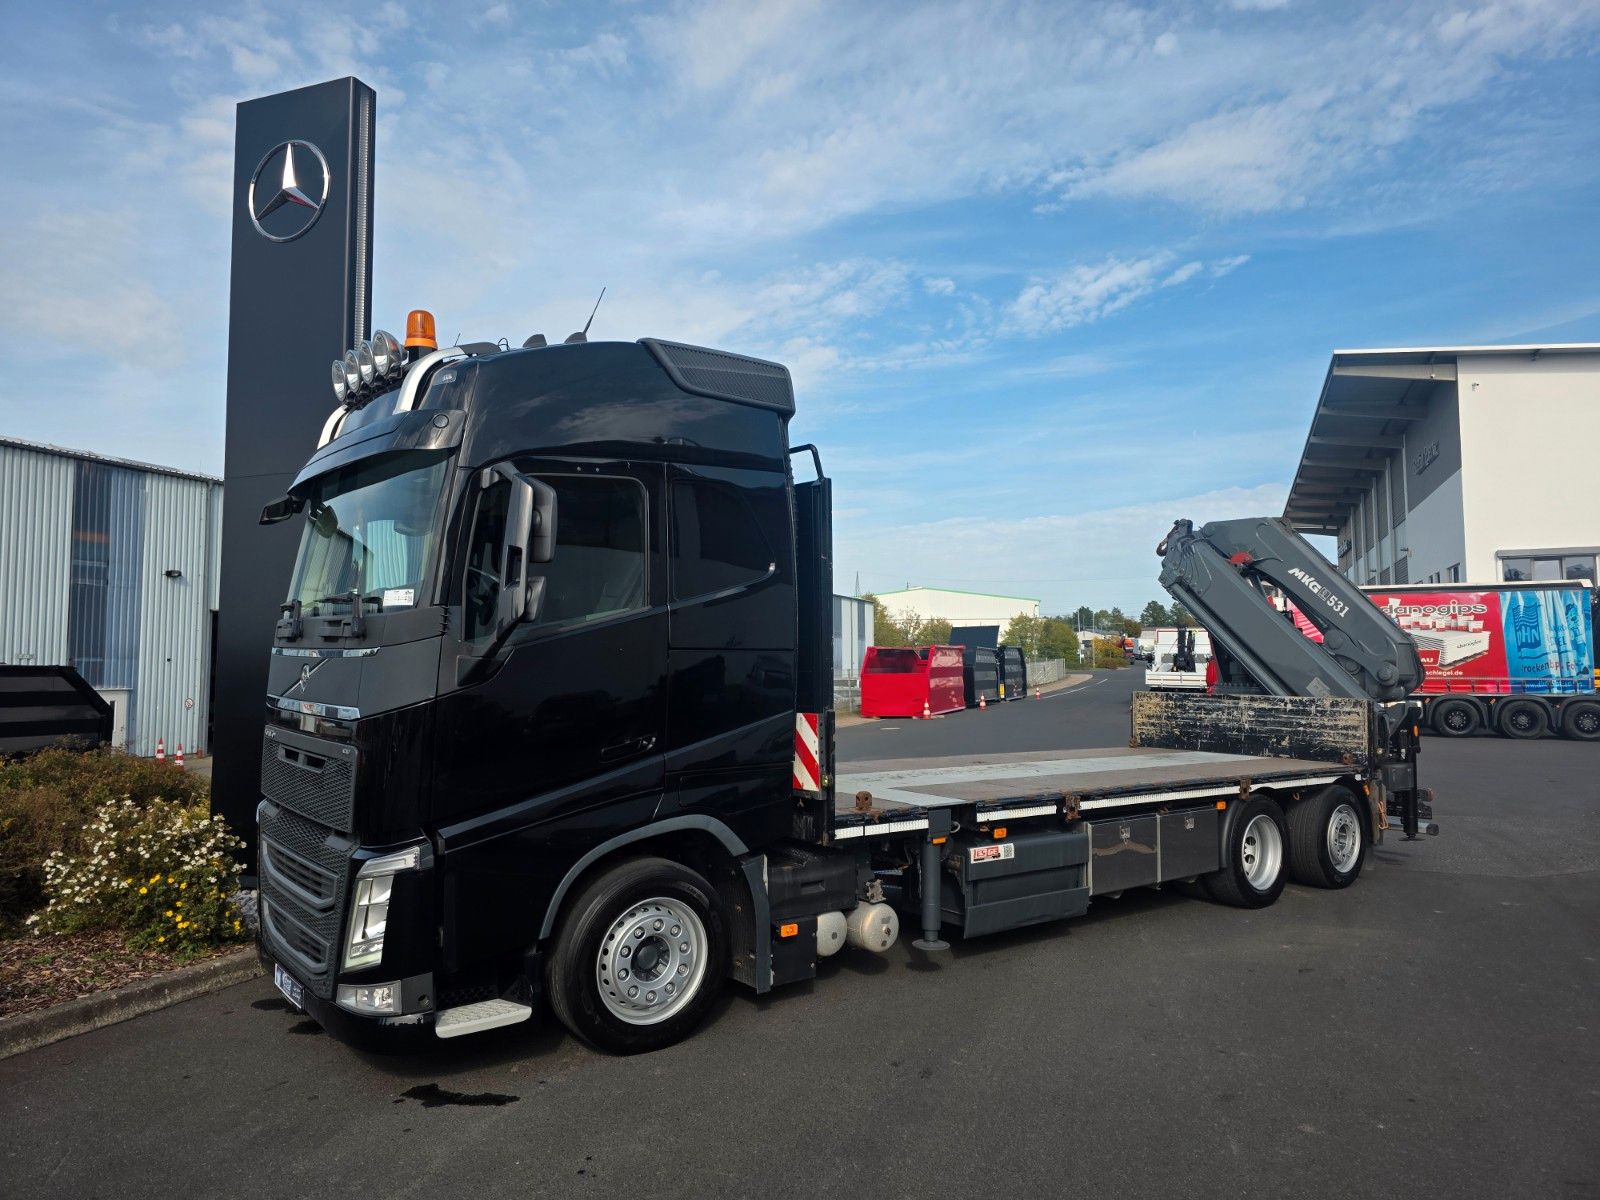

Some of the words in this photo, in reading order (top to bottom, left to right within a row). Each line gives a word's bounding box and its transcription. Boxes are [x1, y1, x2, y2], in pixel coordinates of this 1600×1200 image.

[1288, 568, 1322, 594] MKG
[1327, 595, 1349, 617] 531
[1380, 600, 1487, 616] danogips
